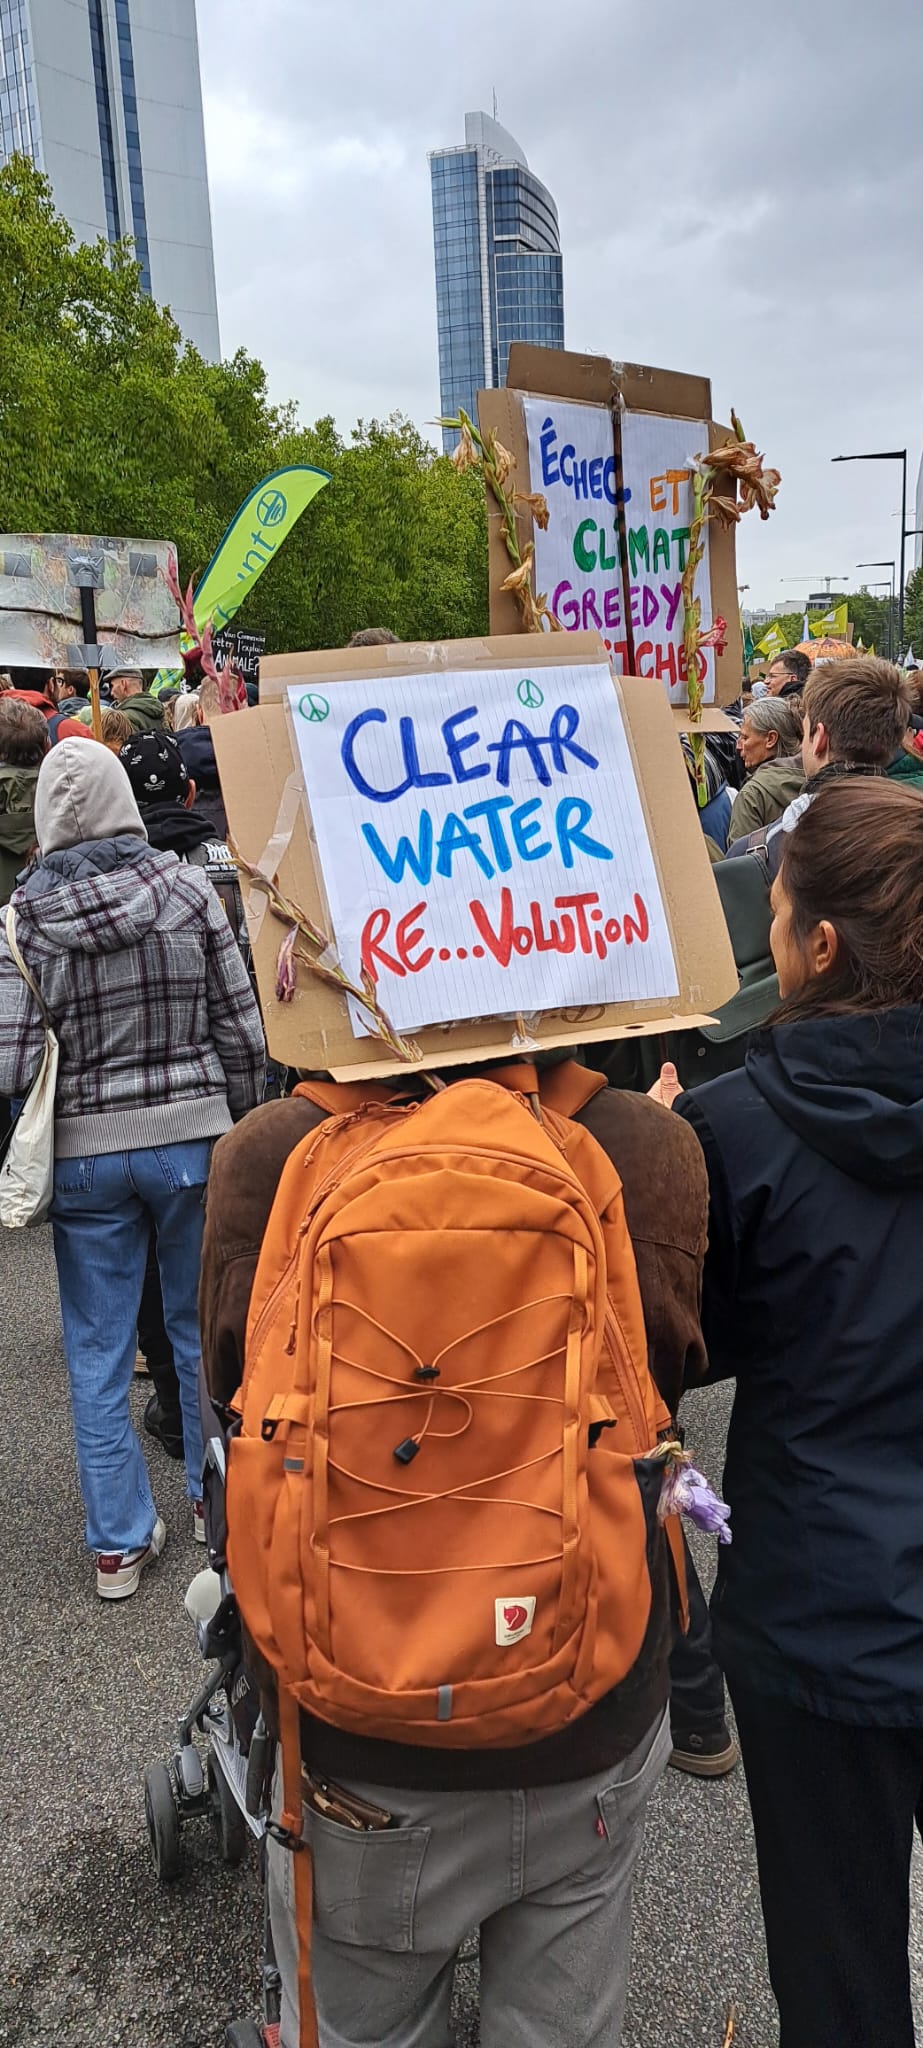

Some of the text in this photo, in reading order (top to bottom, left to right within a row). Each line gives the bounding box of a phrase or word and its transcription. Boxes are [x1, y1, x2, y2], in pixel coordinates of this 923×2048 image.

[540, 417, 690, 516] ÉCHEC ET
[552, 580, 682, 632] GREEDY
[215, 650, 261, 675] ANMALE?
[341, 704, 599, 803] CLEAR
[361, 795, 614, 886] WATER
